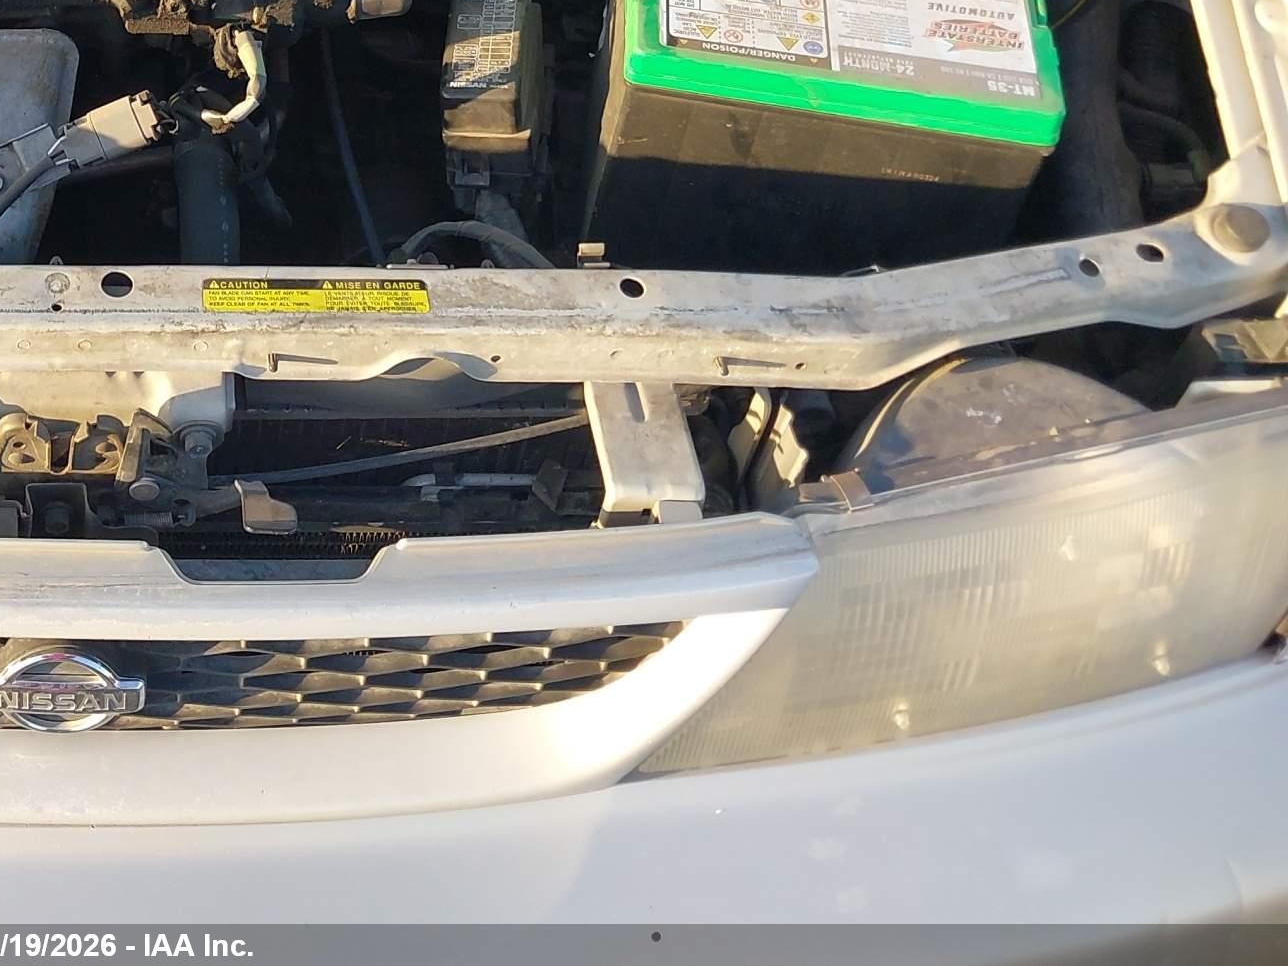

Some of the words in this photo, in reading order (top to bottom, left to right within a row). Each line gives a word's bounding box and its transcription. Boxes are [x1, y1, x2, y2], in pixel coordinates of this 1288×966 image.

[927, 2, 1015, 20] AUTOMOTIVE
[932, 21, 1019, 39] BATTERIES
[927, 28, 1025, 51] INTERSTATE
[702, 42, 796, 62] DANGER/POISON
[843, 55, 915, 76] 24-MONTH
[987, 80, 1036, 97] MT-35
[220, 281, 268, 289] CAUTION
[336, 282, 361, 290] MISE
[365, 282, 380, 290] EN
[384, 282, 421, 290] GARDE
